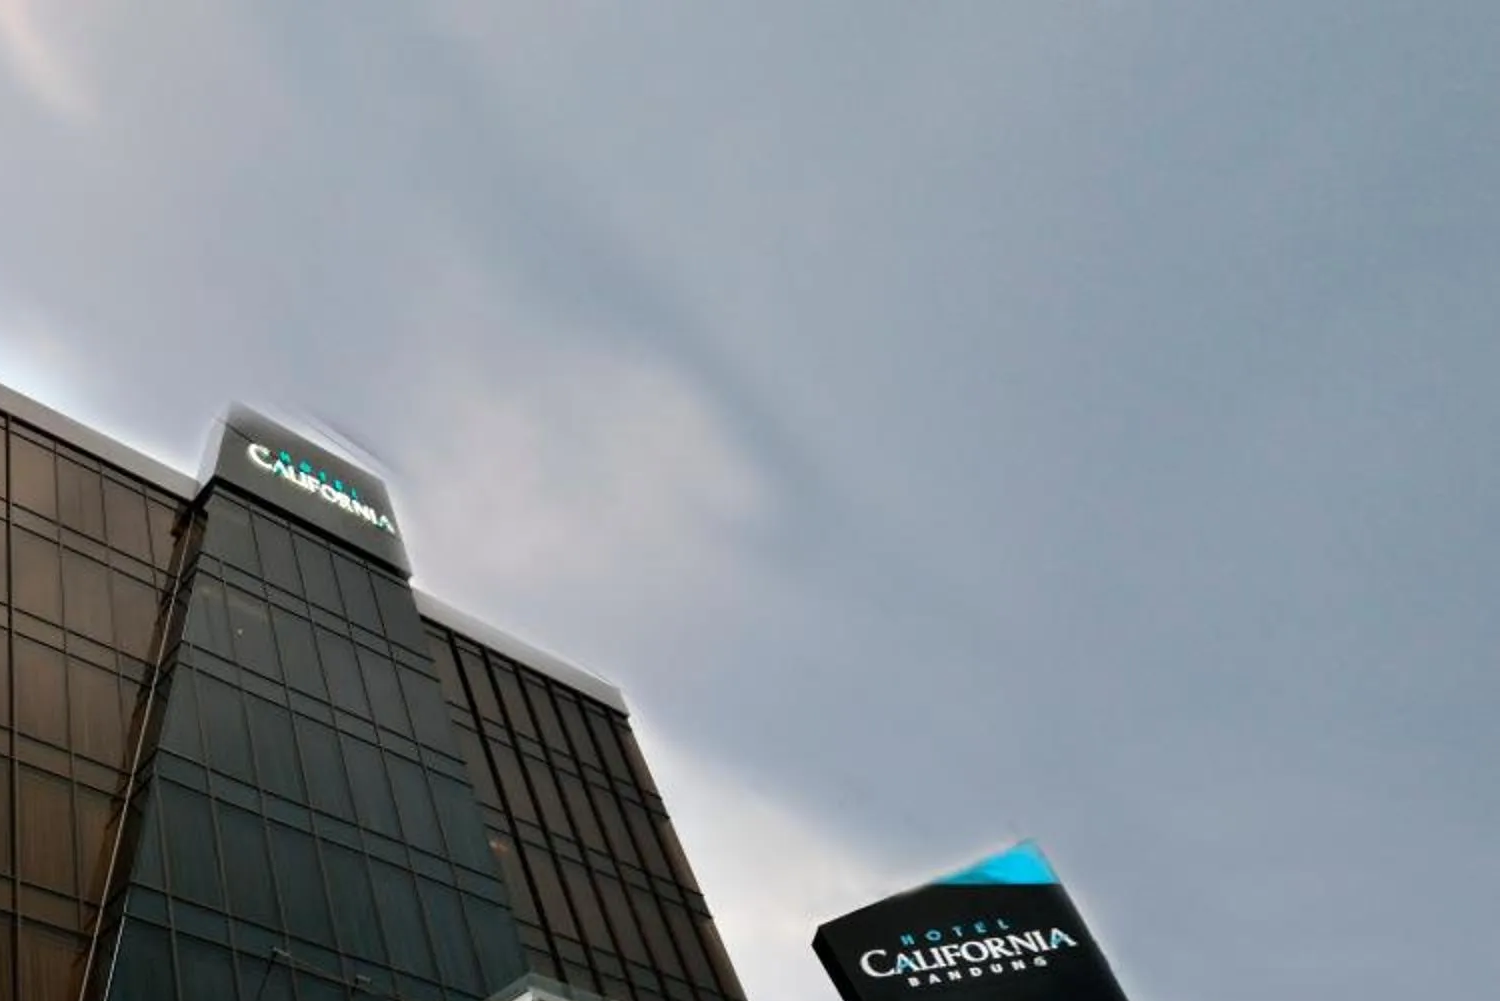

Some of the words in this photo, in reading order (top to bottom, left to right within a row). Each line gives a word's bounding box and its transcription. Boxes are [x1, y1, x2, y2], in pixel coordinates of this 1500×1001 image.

[249, 443, 396, 535] CALIFORNIA
[860, 927, 1077, 978] CALIFORNIA
[901, 918, 1010, 946] HOTEL
[908, 956, 1048, 988] BANDUNG
